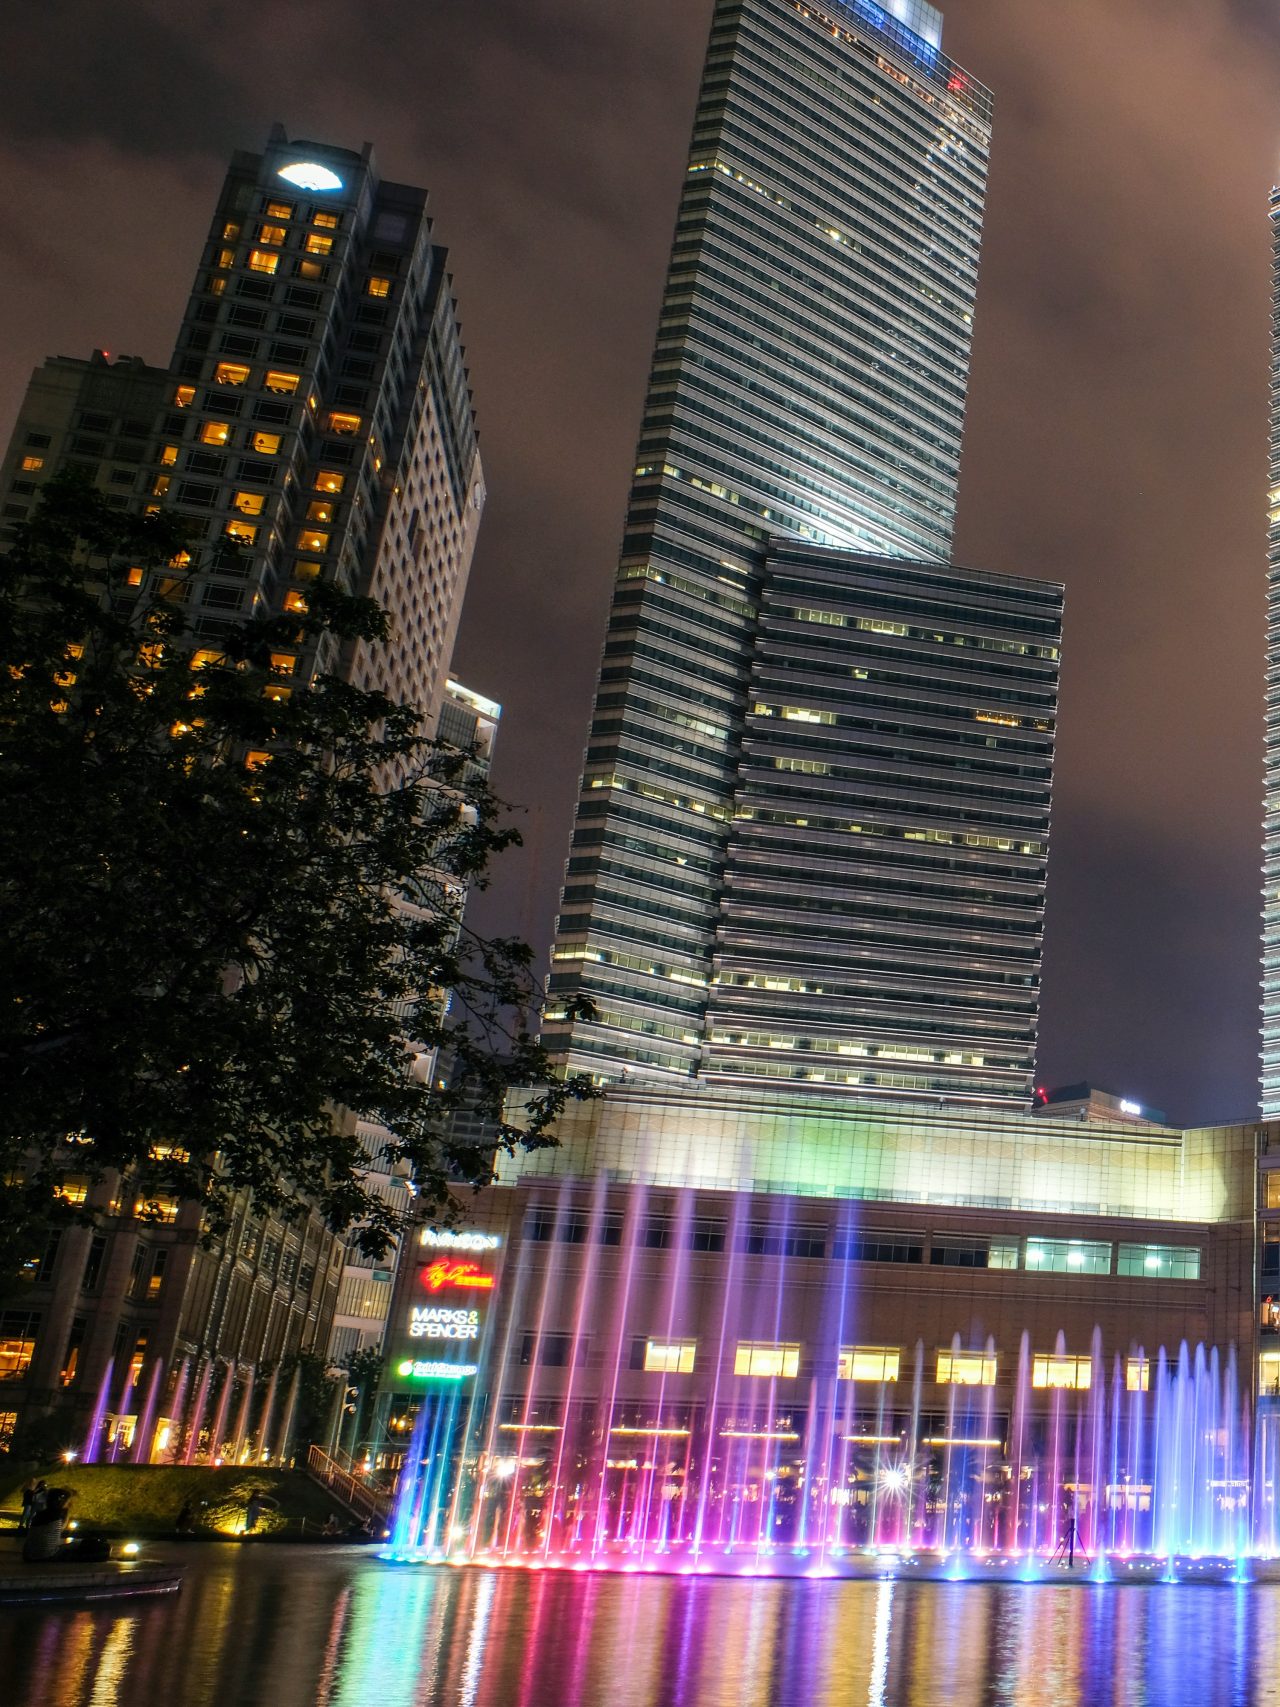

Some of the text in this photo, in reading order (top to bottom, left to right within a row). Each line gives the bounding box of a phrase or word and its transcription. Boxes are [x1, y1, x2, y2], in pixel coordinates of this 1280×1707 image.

[412, 1308, 478, 1325] MARKS &
[409, 1323, 478, 1338] SPENCER
